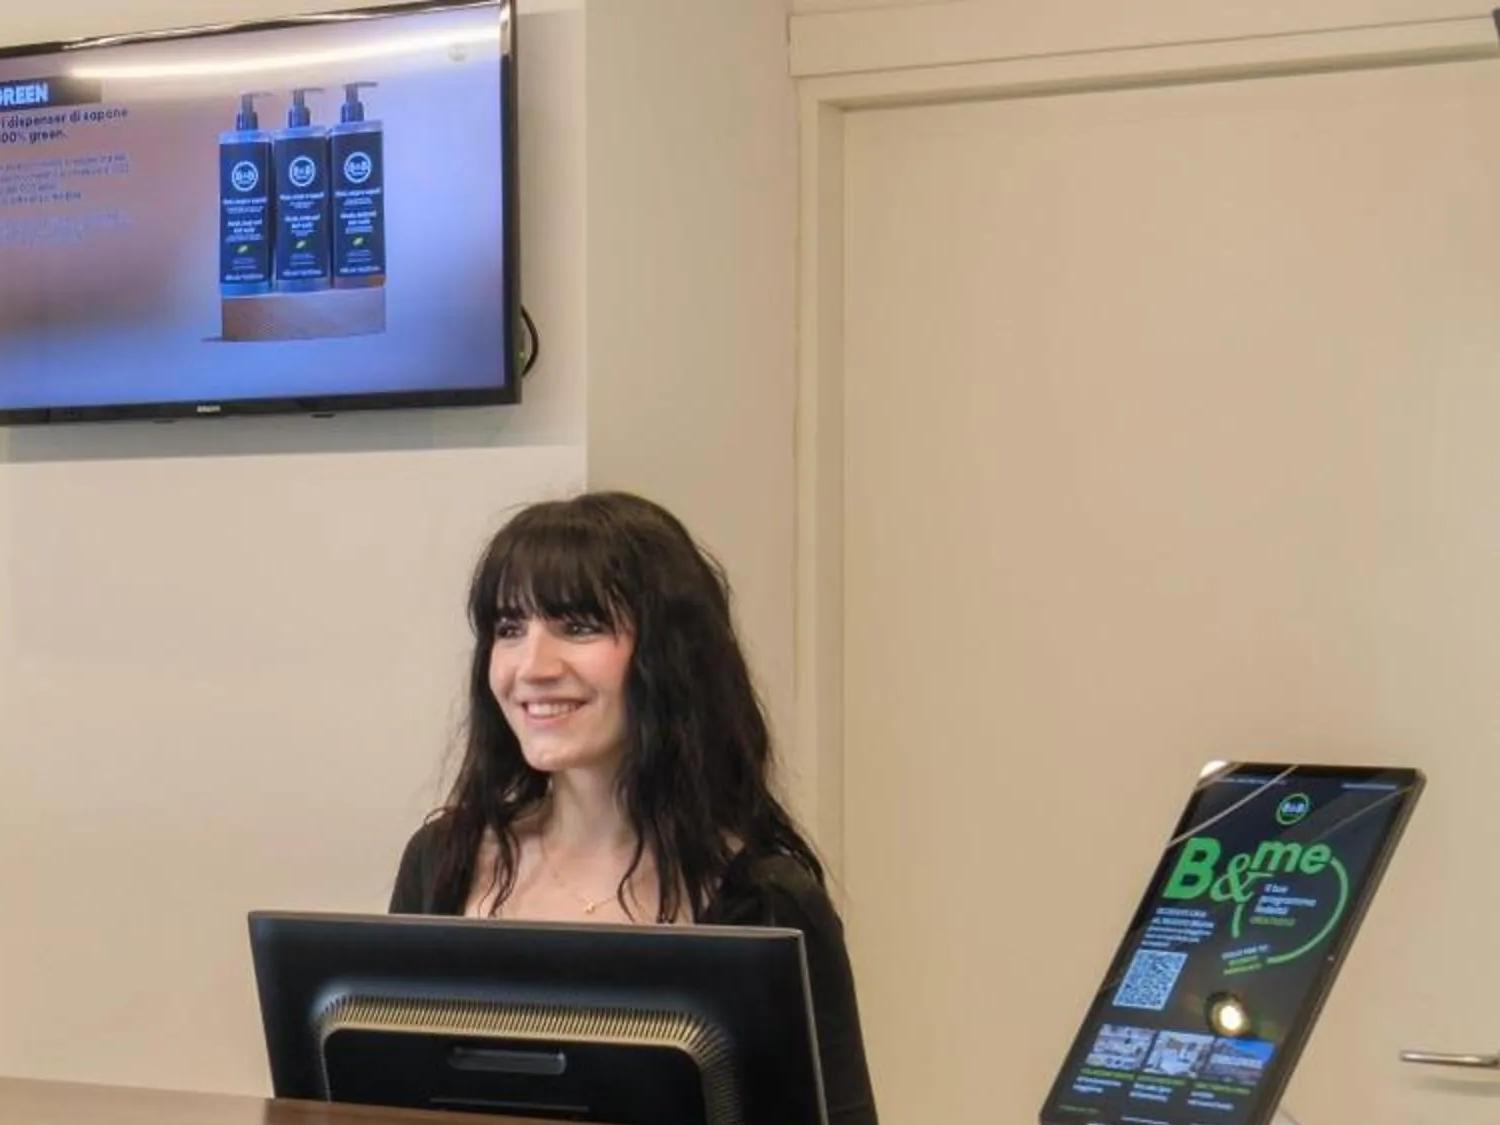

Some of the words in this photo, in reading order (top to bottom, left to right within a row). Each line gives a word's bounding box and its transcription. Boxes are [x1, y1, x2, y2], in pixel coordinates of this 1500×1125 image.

[7, 113, 66, 129] dispenser
[70, 110, 81, 123] di
[84, 107, 128, 122] sapone
